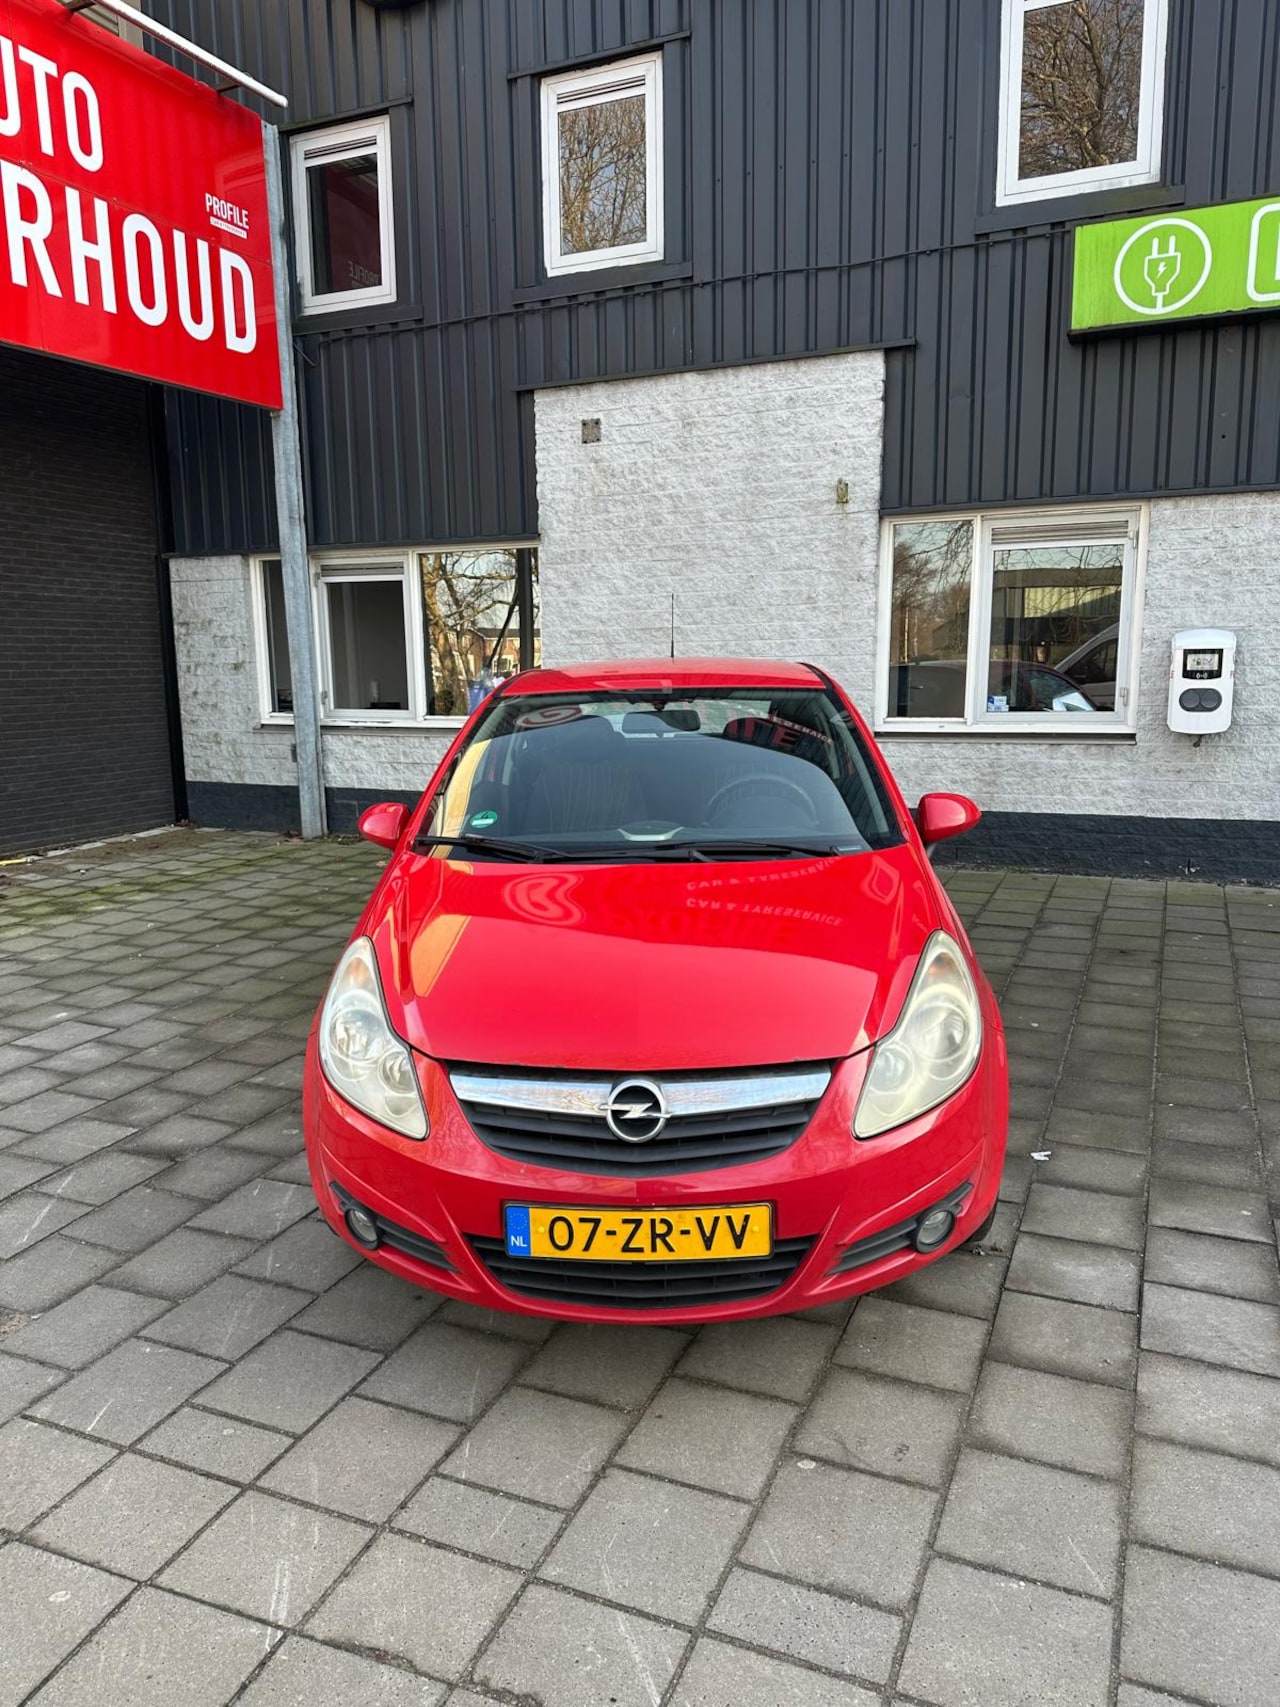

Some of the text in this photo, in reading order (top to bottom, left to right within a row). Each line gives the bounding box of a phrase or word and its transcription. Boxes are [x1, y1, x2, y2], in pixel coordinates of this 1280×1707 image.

[205, 192, 249, 230] PROFILE
[0, 160, 257, 354] RHOUD
[510, 1235, 528, 1248] NL
[548, 1213, 751, 1254] 07-ZR-VV
